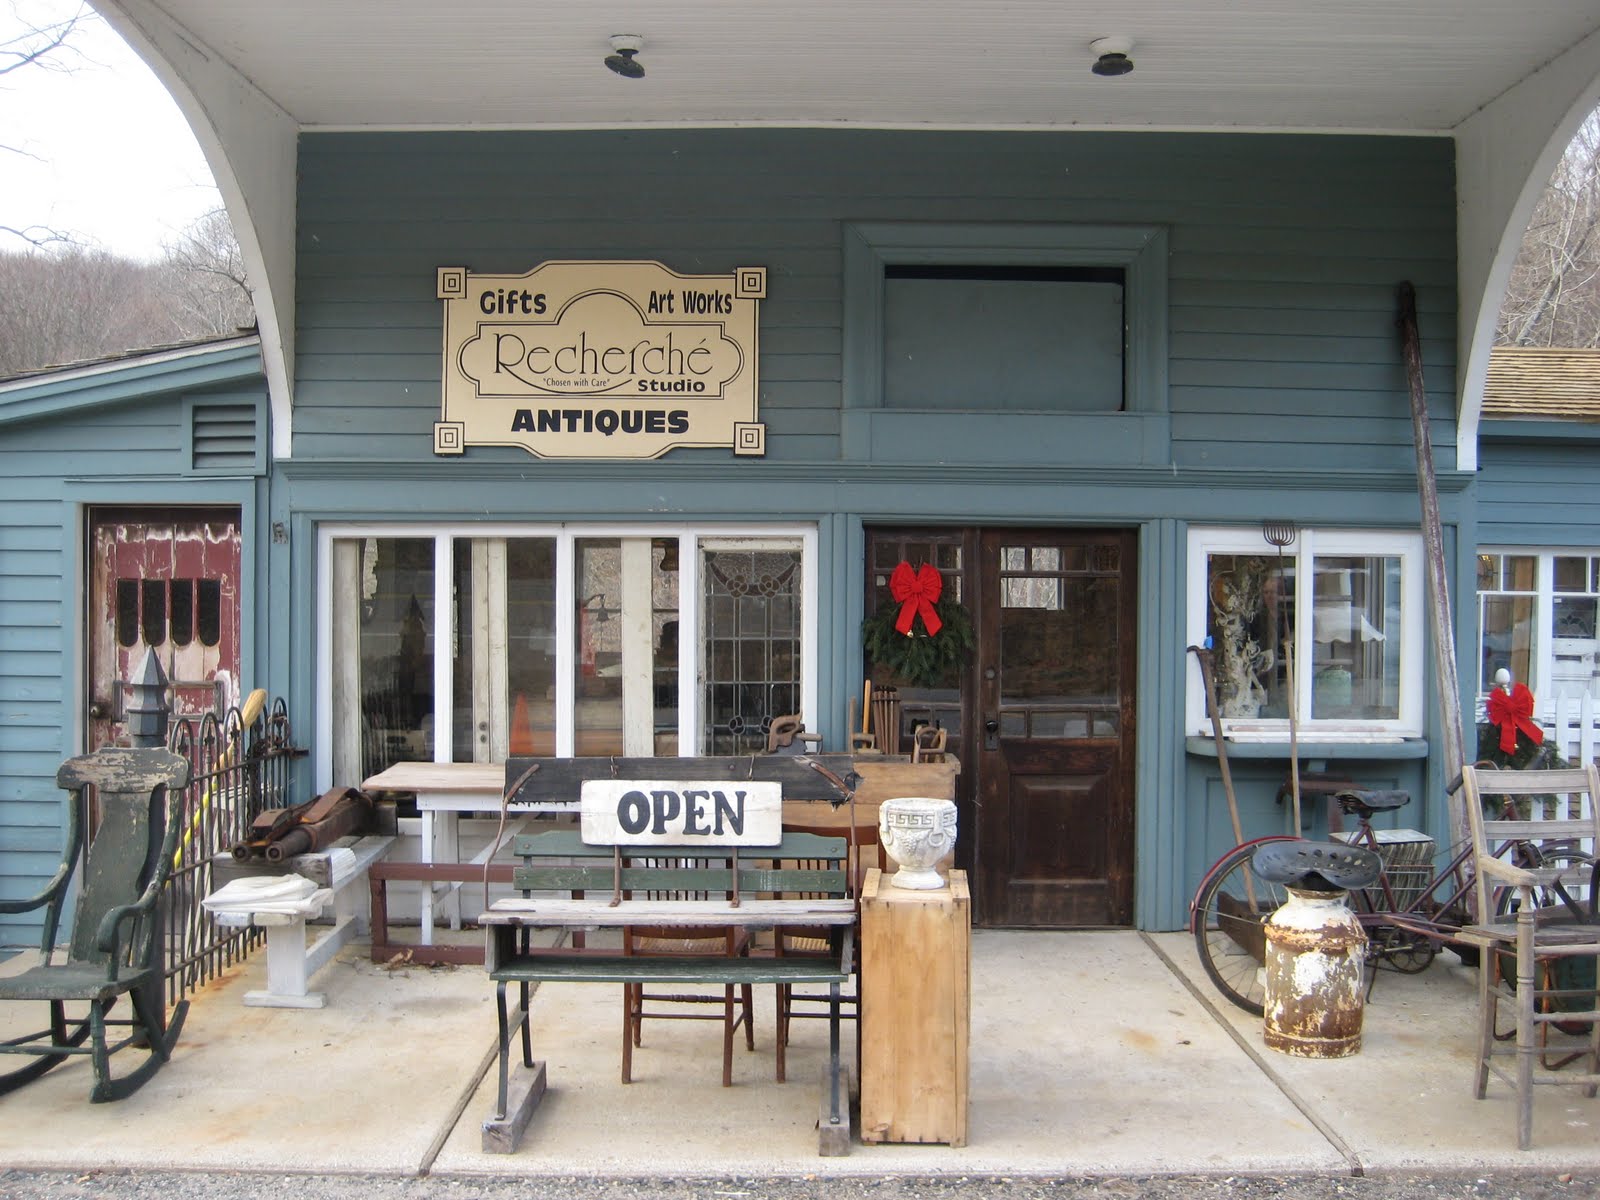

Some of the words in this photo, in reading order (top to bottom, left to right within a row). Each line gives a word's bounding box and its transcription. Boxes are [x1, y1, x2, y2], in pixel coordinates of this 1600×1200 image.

[480, 289, 547, 315] Gifts
[648, 290, 675, 314] Art
[682, 289, 732, 315] Works
[492, 331, 714, 394] Recherché
[573, 377, 589, 388] with
[637, 378, 706, 393] Studio
[510, 409, 690, 436] ANTIQUES
[617, 789, 747, 836] OPEN
